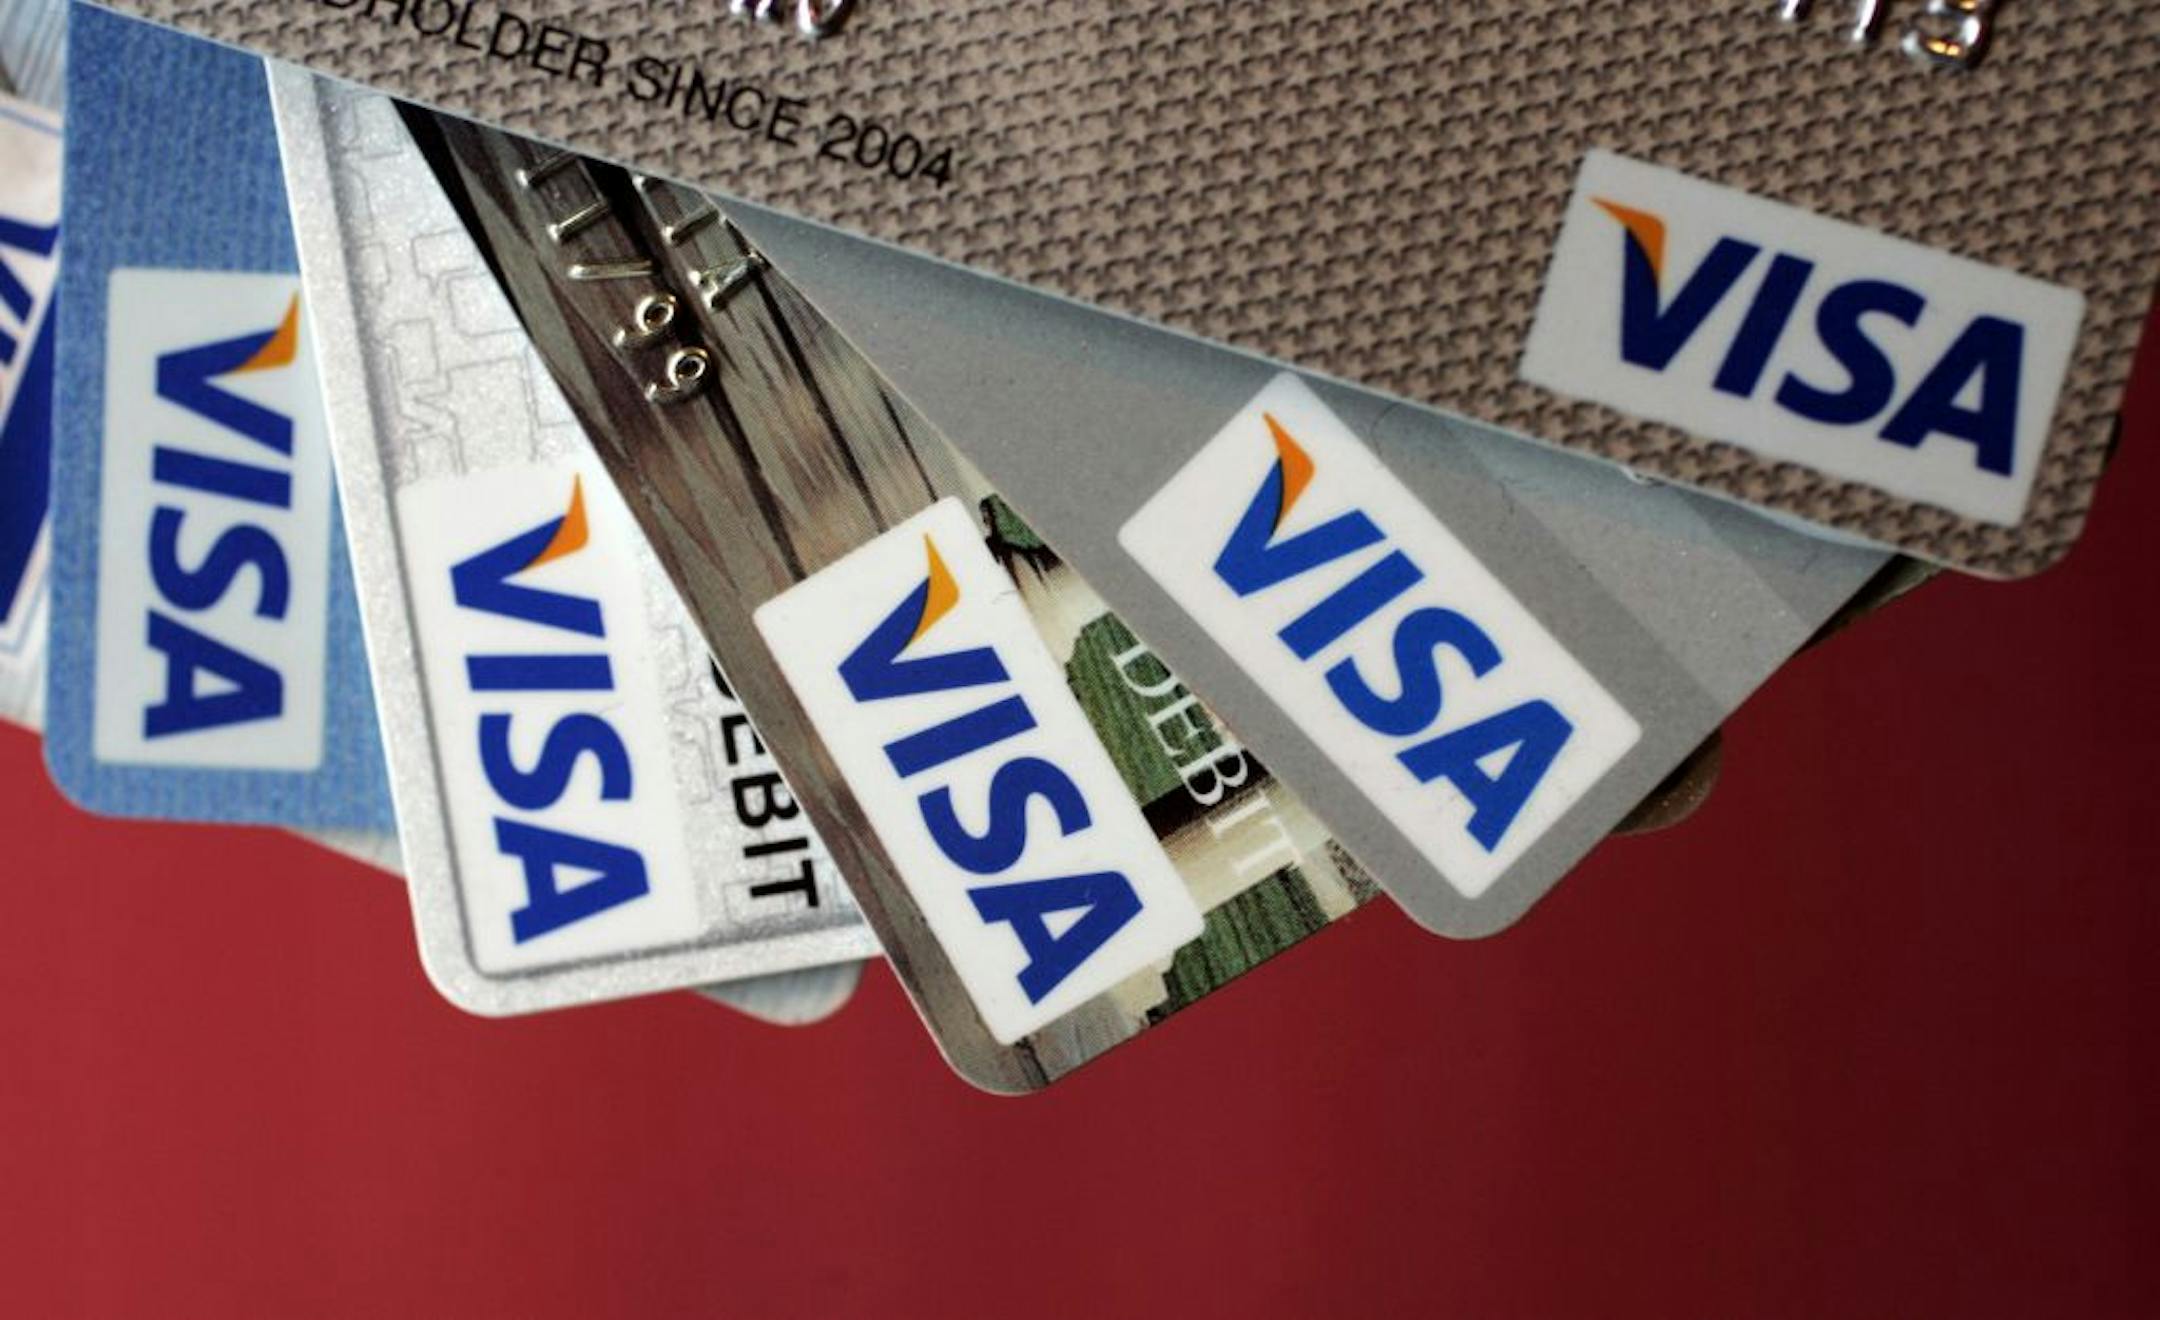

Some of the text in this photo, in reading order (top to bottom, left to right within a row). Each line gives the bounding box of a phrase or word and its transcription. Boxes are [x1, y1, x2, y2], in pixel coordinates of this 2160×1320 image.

[627, 57, 807, 148] SINCE
[819, 114, 955, 189] 2004
[144, 290, 299, 740] VISA
[1590, 196, 2025, 478] VISA
[450, 472, 651, 945] VISA
[708, 653, 819, 908] EBIT
[837, 535, 1144, 1005] VISA
[1110, 641, 1305, 876] DEBIT
[1212, 411, 1575, 854] VISA
